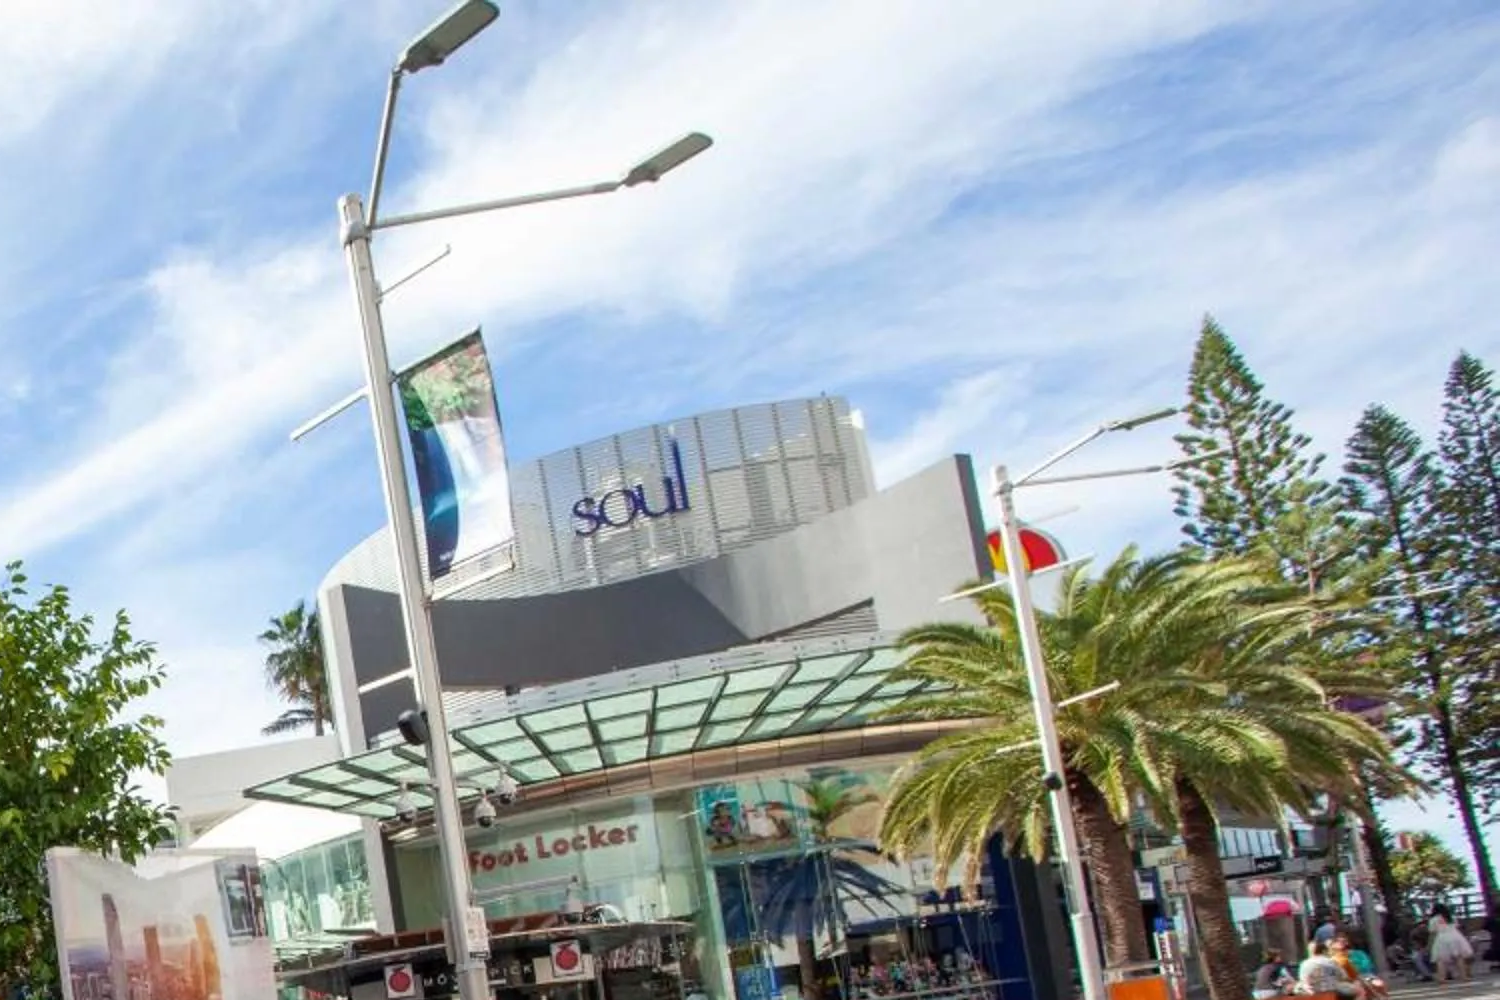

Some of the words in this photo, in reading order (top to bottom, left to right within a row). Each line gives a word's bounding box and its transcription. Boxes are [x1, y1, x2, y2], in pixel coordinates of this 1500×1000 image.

[573, 425, 689, 536] soul
[469, 842, 528, 875] Foot
[535, 825, 638, 859] Locker
